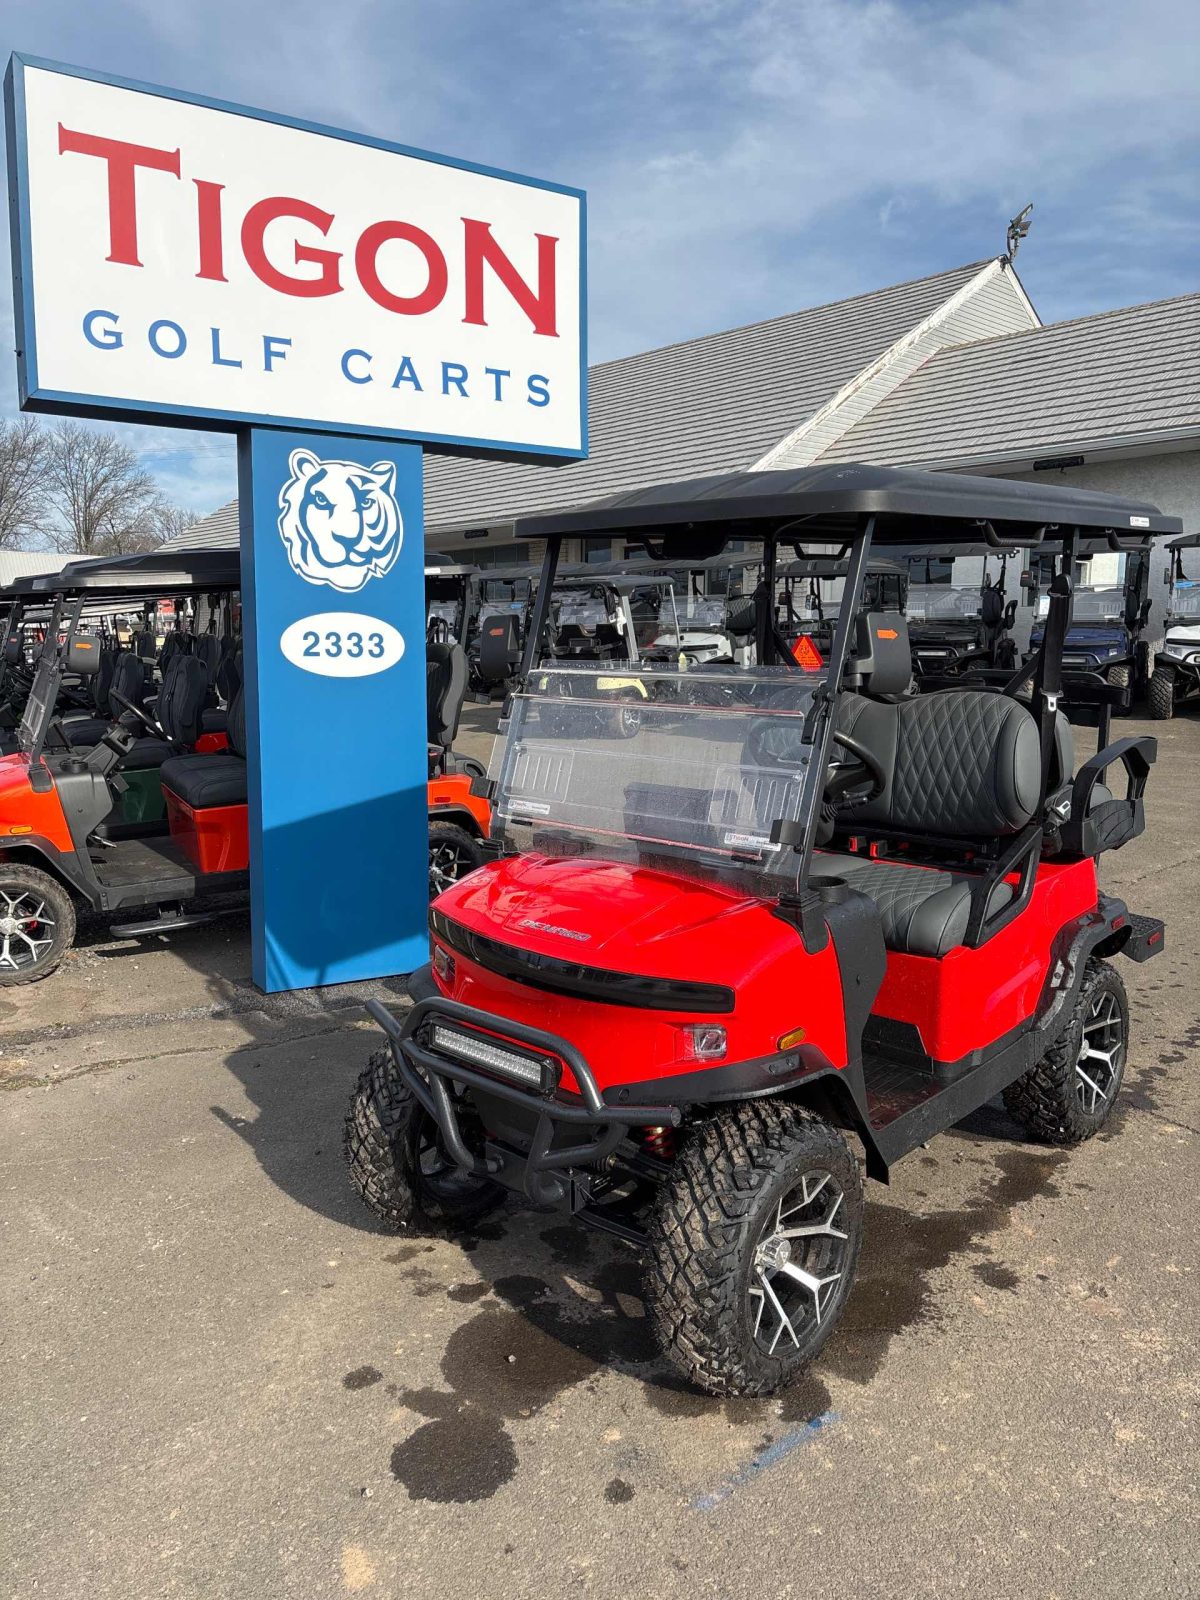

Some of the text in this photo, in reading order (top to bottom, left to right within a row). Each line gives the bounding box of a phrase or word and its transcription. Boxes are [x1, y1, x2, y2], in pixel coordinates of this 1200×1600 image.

[58, 122, 558, 337] TIGON
[83, 309, 551, 408] GOLF CARTS
[302, 630, 385, 659] 2333
